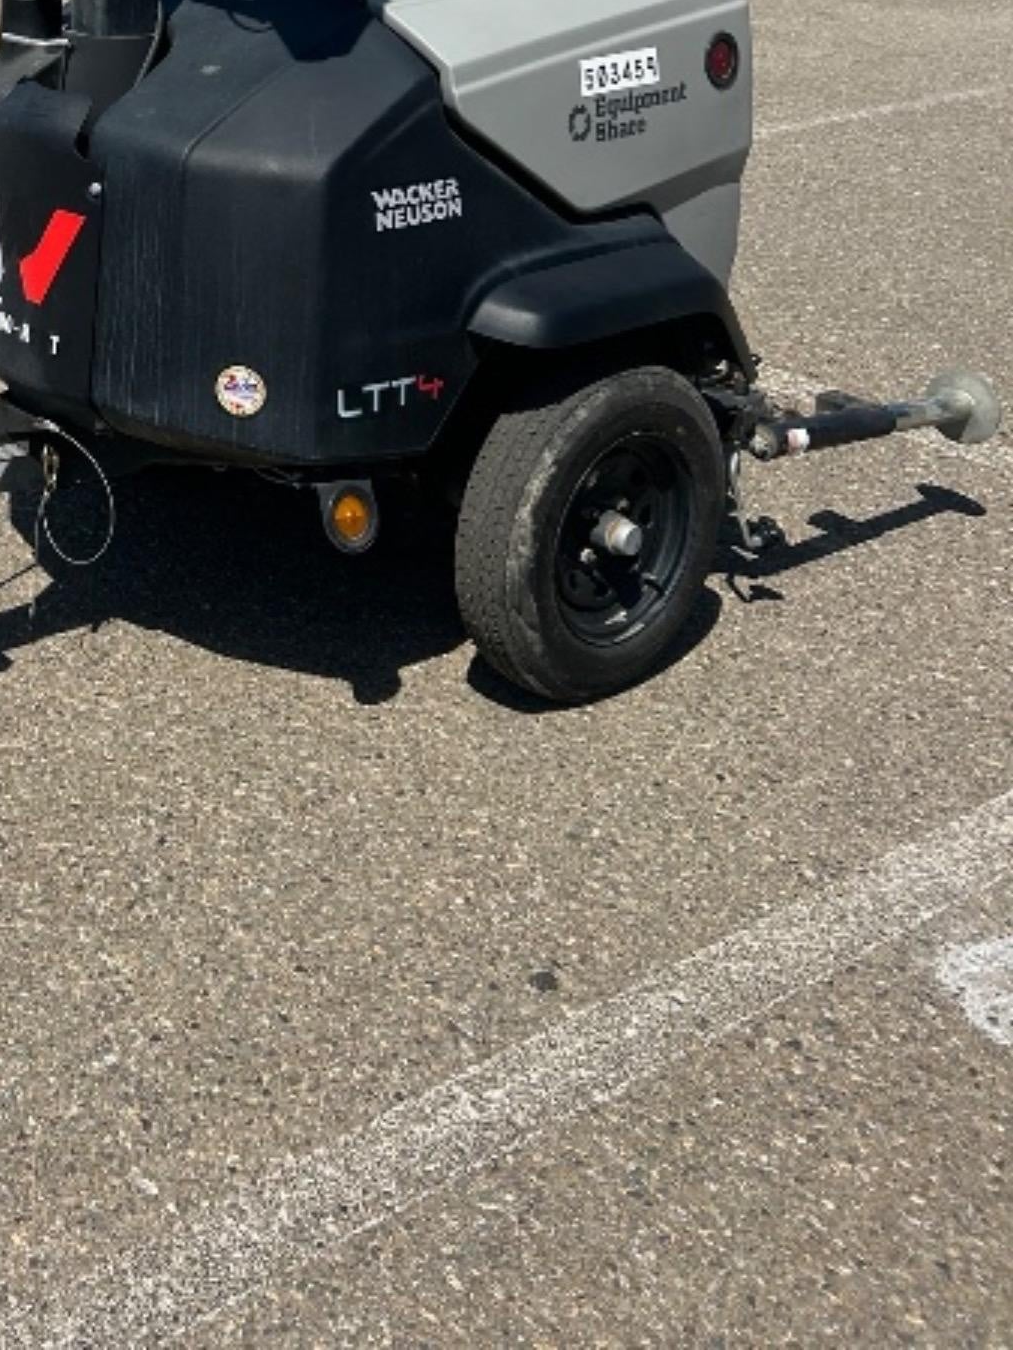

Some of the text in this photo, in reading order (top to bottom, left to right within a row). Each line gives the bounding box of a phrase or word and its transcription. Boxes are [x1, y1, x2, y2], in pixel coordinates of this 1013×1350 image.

[370, 177, 460, 211] WACKER
[375, 197, 463, 232] NEUSON
[337, 374, 444, 418] LTT4
